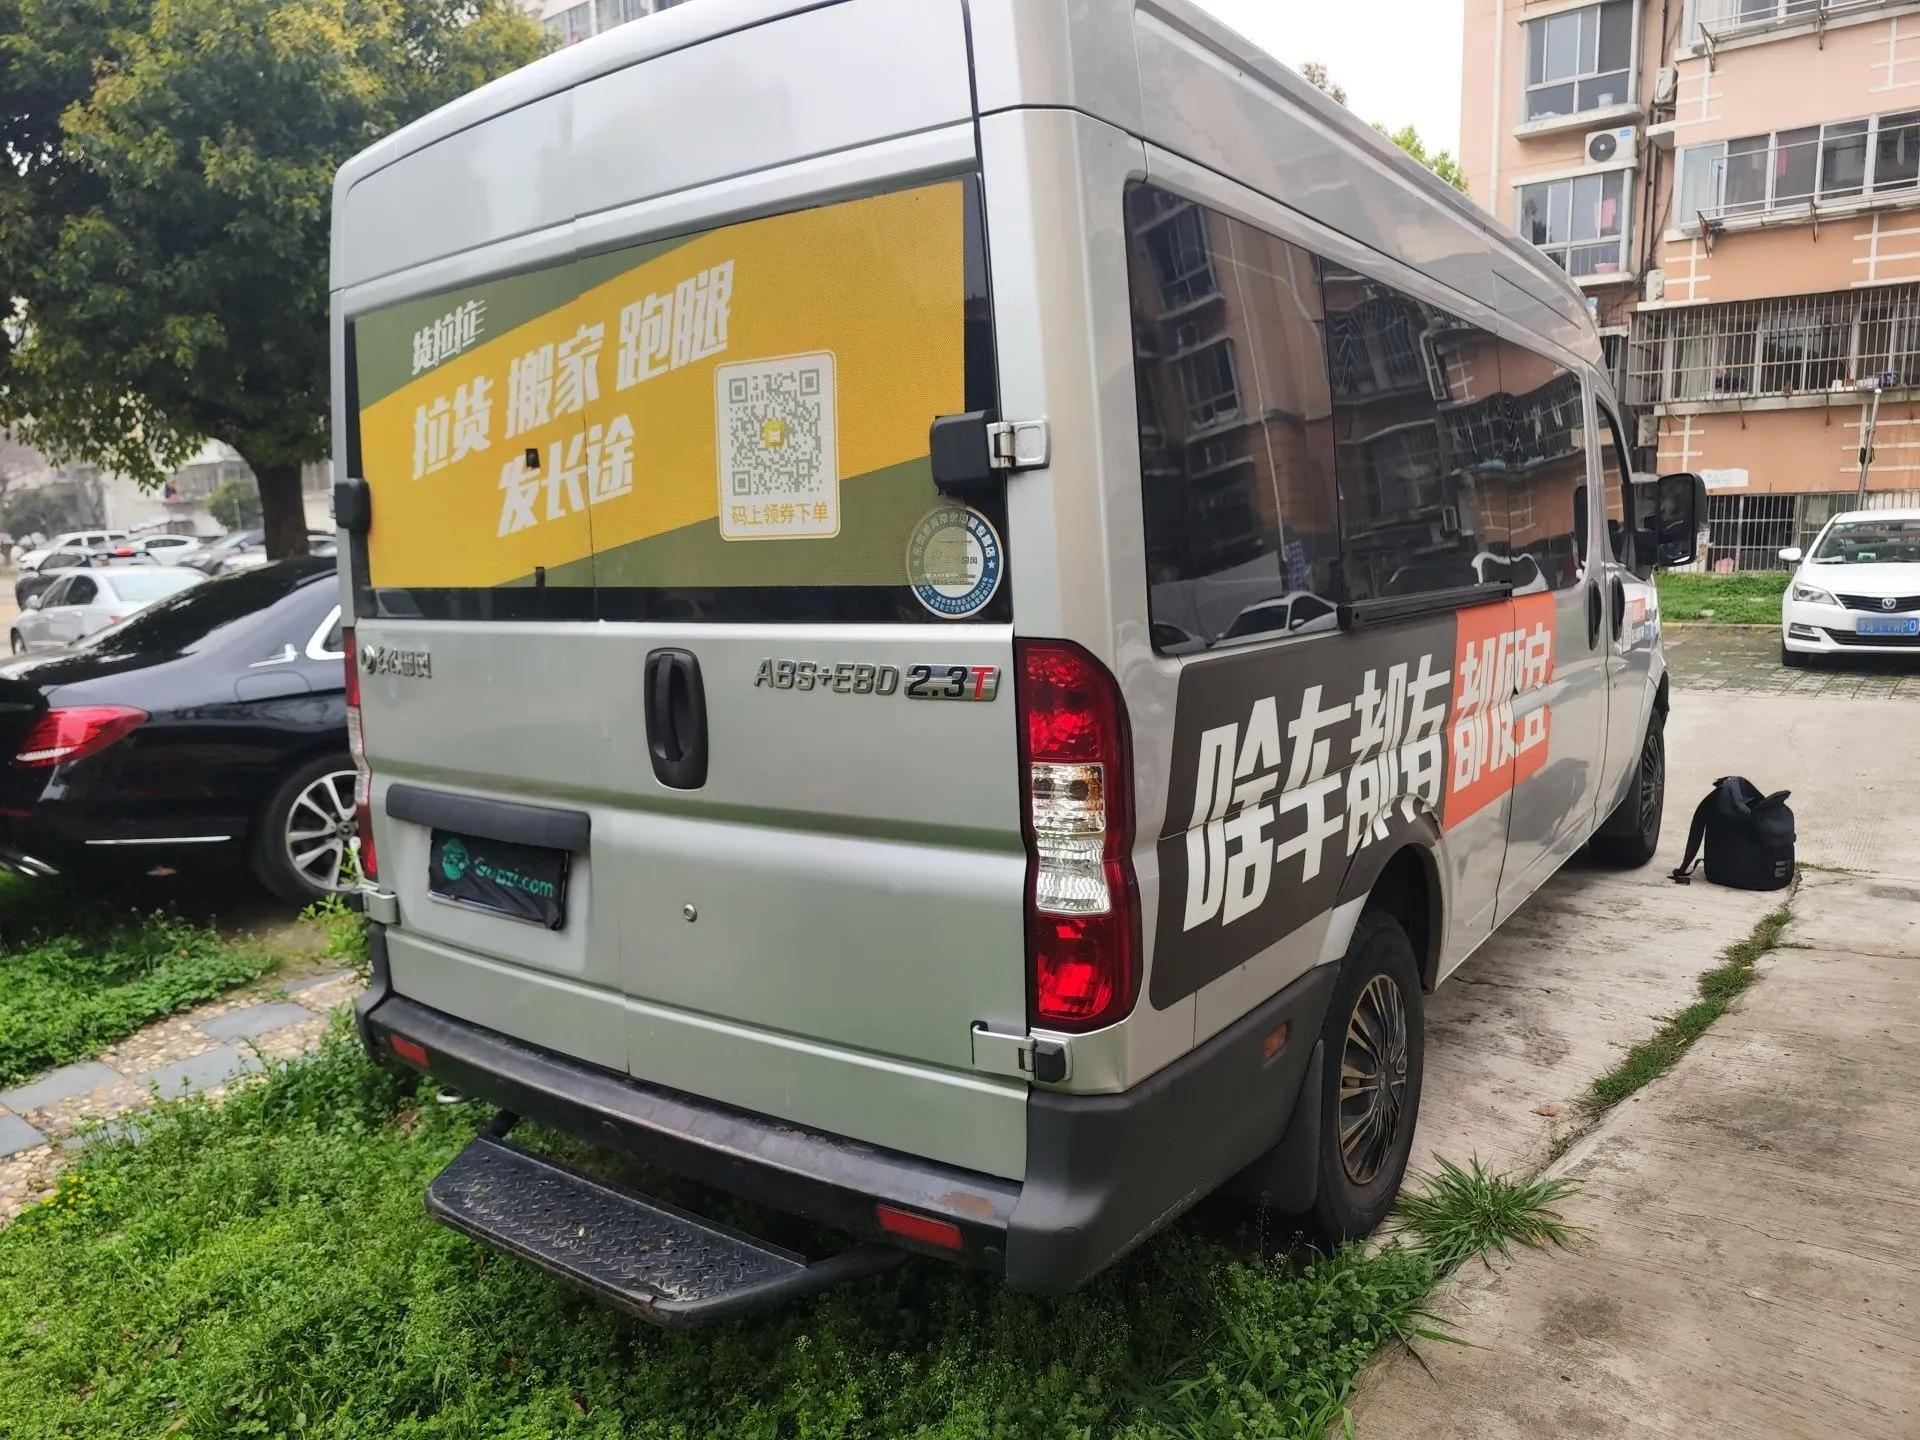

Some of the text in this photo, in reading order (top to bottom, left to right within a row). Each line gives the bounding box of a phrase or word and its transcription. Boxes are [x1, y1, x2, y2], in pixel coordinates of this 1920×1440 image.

[412, 300, 488, 376] 货拉拉
[412, 258, 736, 481] 拉货 搬家 跑腿
[497, 413, 635, 537] 发长途
[754, 657, 994, 701] ABS+EBD 2.3T
[1183, 654, 1451, 932] 啥车都有
